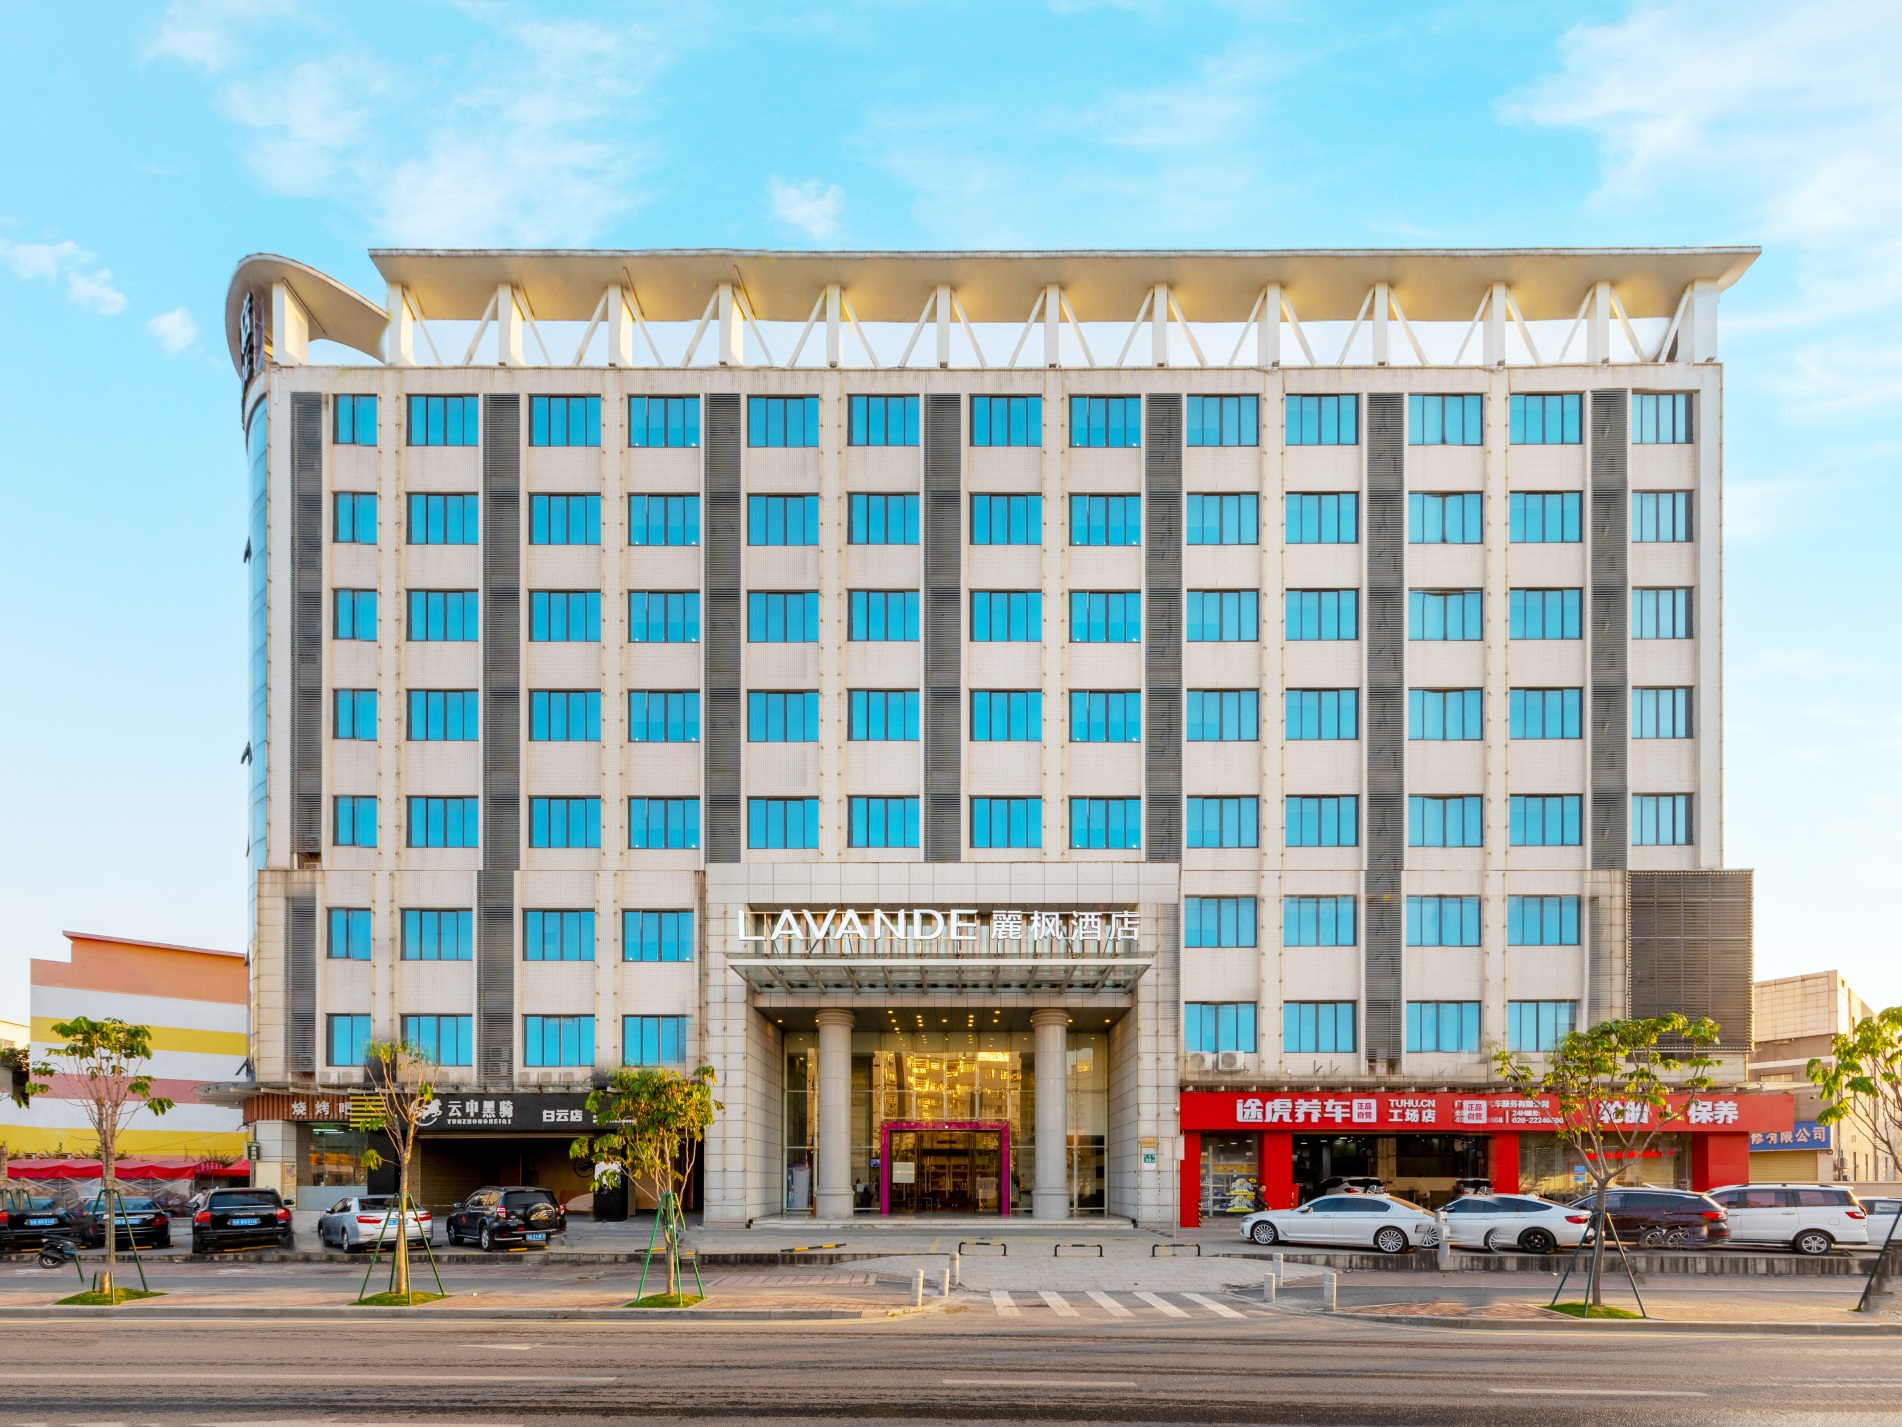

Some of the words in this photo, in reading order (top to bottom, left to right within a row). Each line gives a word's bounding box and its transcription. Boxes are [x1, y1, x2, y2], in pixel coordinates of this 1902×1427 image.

[738, 909, 978, 941] LAVANDE
[990, 910, 1140, 941] 麗枫酒店
[448, 1099, 513, 1118] 云中黑骑
[1357, 1102, 1372, 1110] 正品
[1388, 1099, 1435, 1108] TUHU.CN
[1468, 1103, 1482, 1111] 正品
[542, 1109, 583, 1122] 白云店
[1236, 1098, 1351, 1123] 途虎养车
[1357, 1111, 1373, 1119] 自营
[1388, 1109, 1436, 1123] 工场店
[1468, 1112, 1482, 1120] 自营
[1598, 1100, 1648, 1124] 轮胎
[1687, 1100, 1739, 1124] 保养
